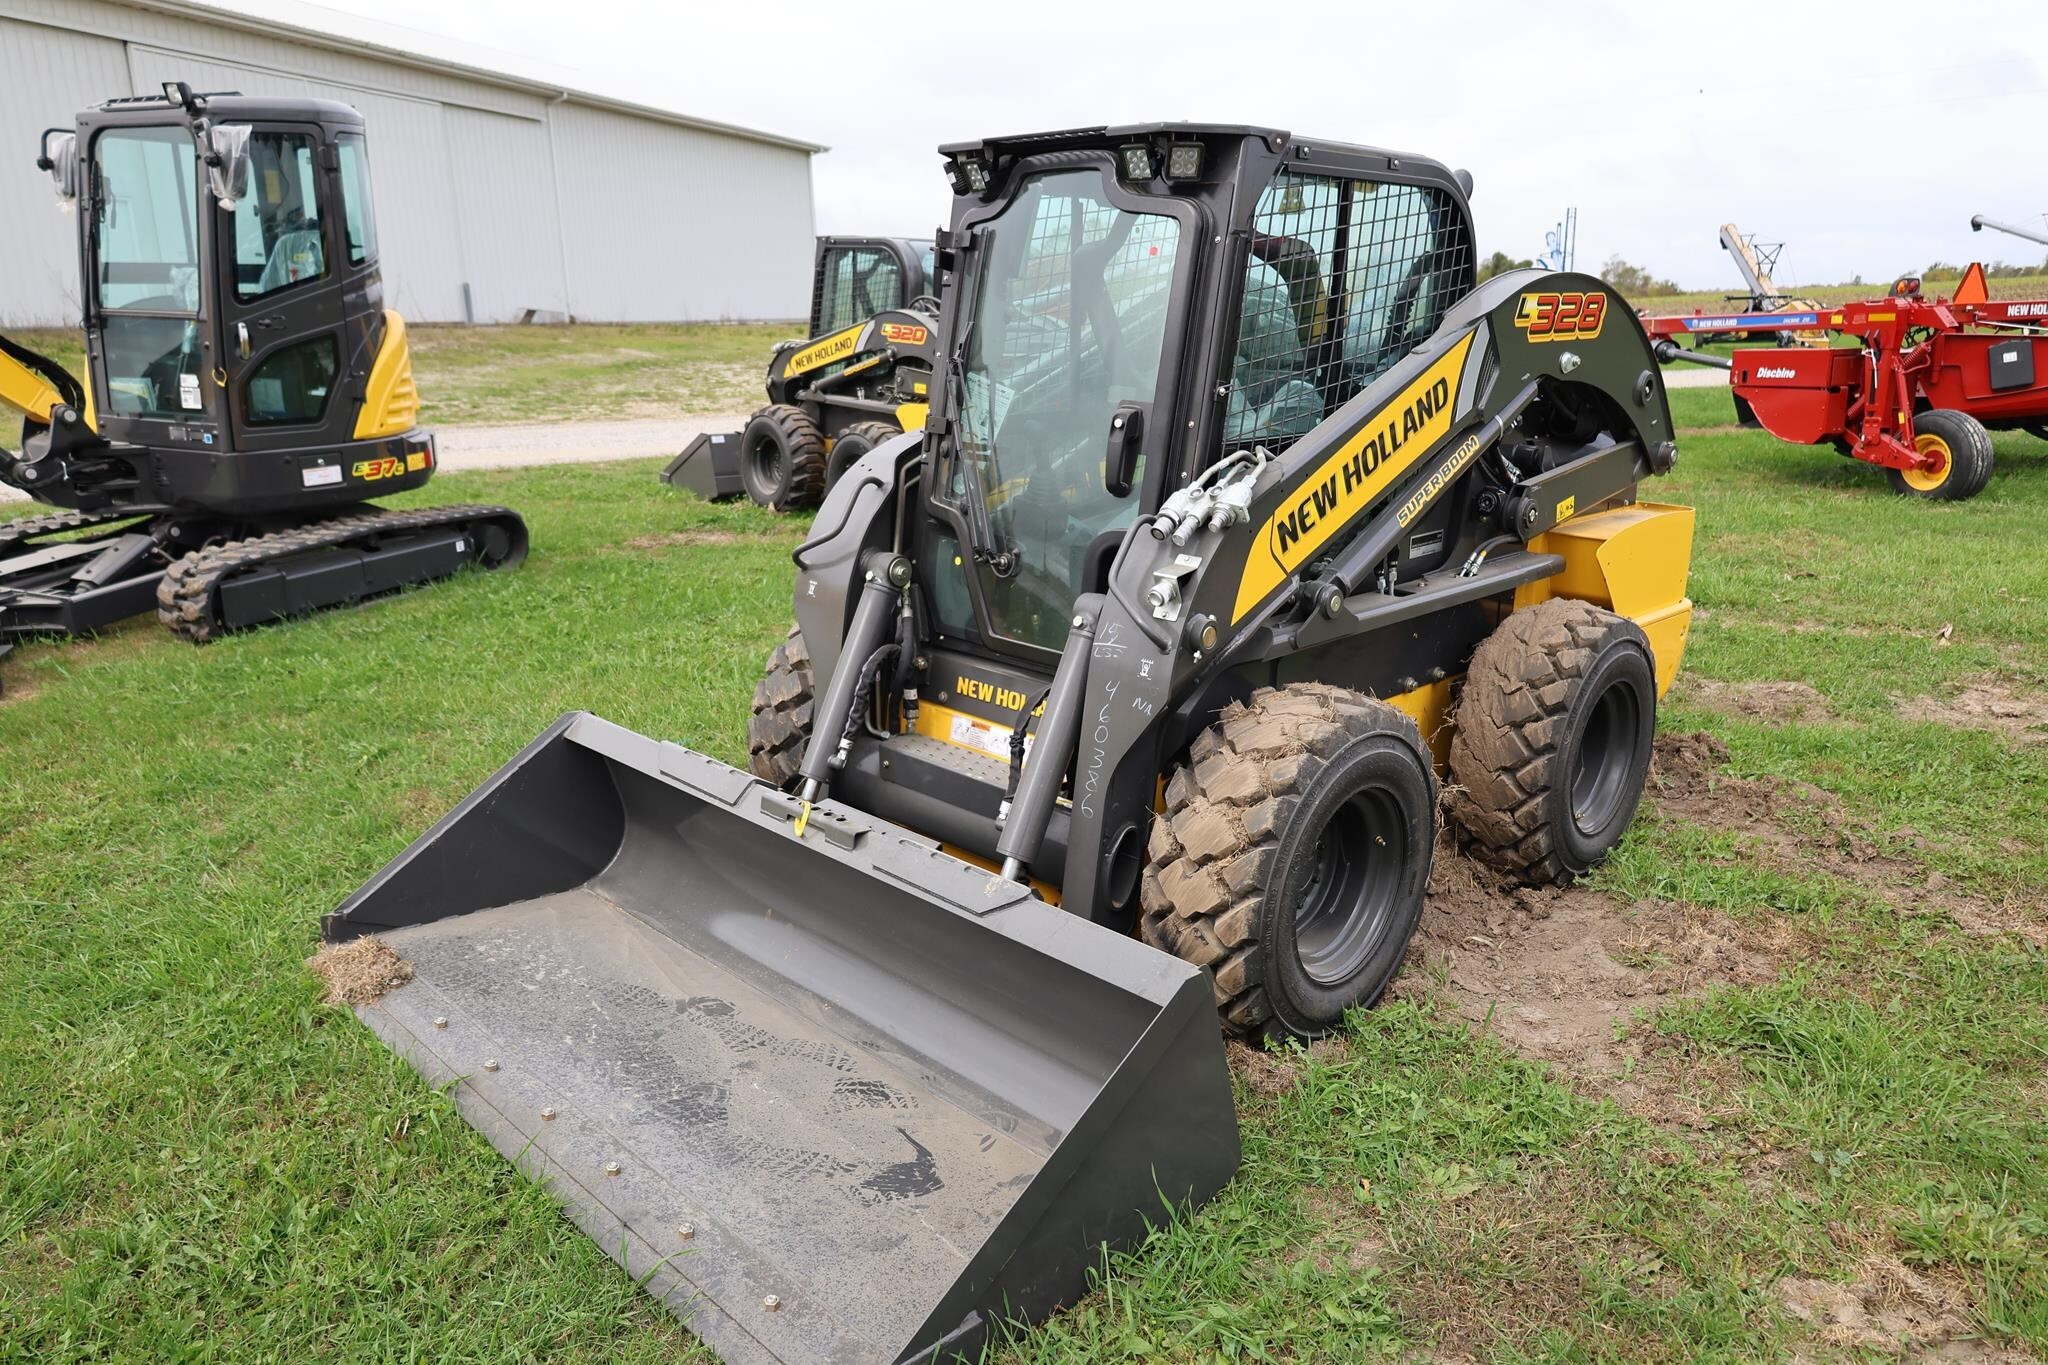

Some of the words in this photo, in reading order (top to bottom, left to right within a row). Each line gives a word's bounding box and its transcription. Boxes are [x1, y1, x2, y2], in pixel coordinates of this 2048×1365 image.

[1515, 292, 1607, 342] L328
[1712, 317, 1737, 327] HOLLAND
[2007, 304, 2030, 317] NEW
[881, 323, 928, 345] L320
[795, 356, 814, 369] NEW
[815, 337, 852, 362] HOLLAND
[1757, 367, 1796, 379] Discbine
[1277, 473, 1338, 554] NEW
[1342, 376, 1449, 496] HOLLAND
[1397, 474, 1444, 528] SUPER
[1440, 435, 1480, 482] BOOM
[957, 676, 994, 703] NEW
